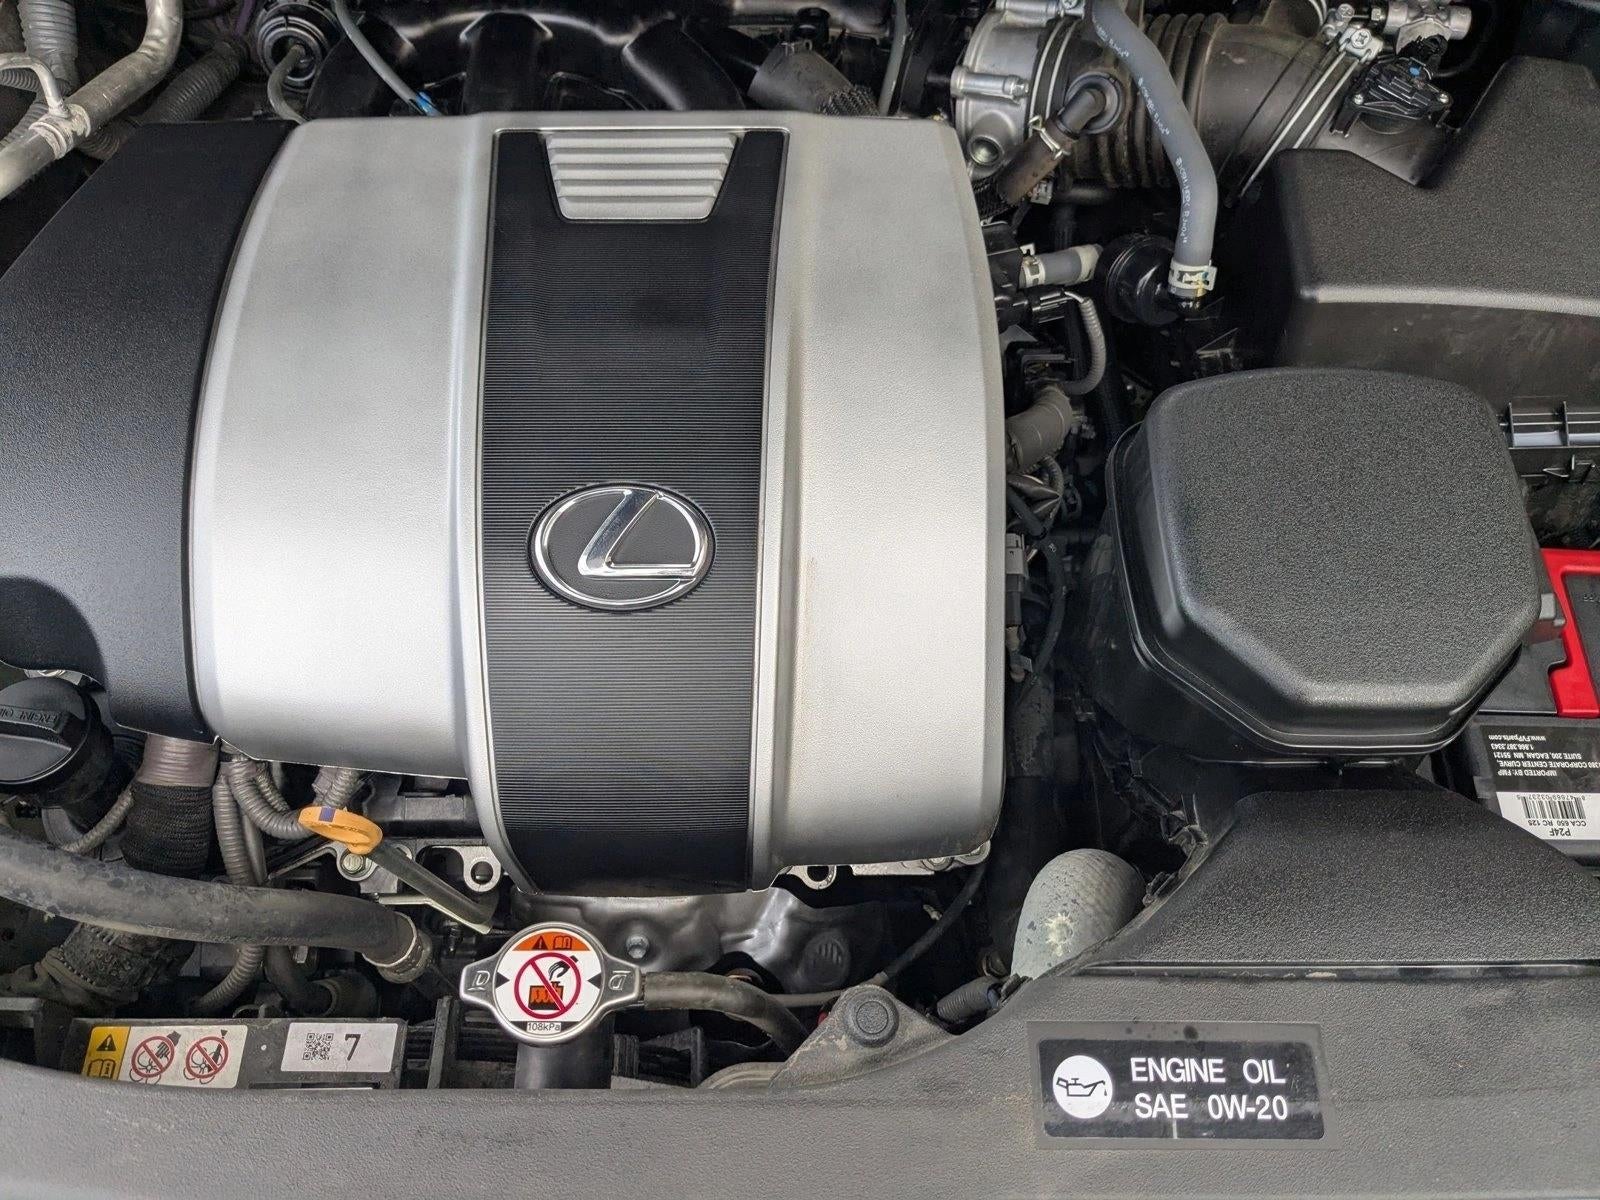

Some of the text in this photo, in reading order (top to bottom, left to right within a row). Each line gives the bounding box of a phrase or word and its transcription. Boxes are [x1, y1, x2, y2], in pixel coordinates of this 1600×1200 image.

[1488, 734, 1546, 742] www.FVPparts.com
[1563, 752, 1582, 760] SUITE
[1497, 759, 1521, 767] CURVE,
[1522, 760, 1547, 768] CENTER
[1524, 769, 1557, 777] IMPORTED
[1549, 827, 1572, 837] P24F
[527, 1022, 561, 1032] 108kPa
[344, 1033, 362, 1062] 7
[1130, 1056, 1286, 1084] ENGINE OIL
[1134, 1092, 1288, 1120] SAE 0W-20
